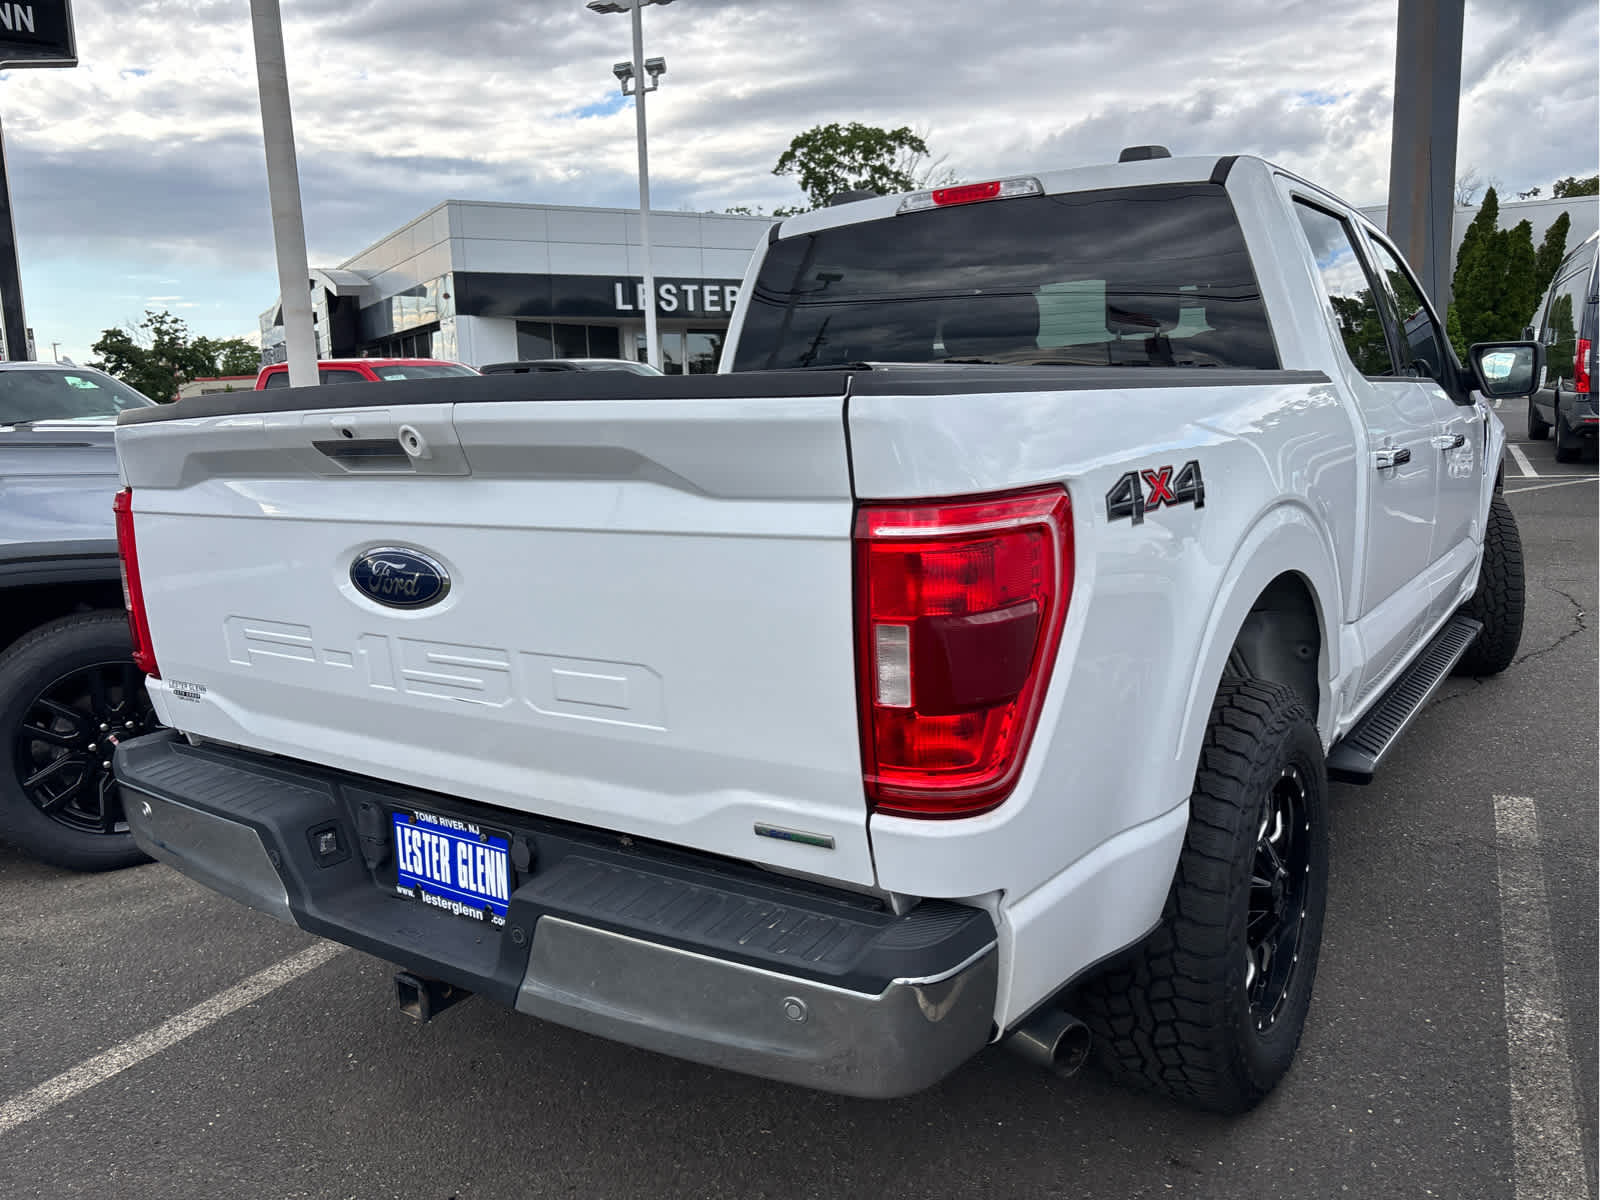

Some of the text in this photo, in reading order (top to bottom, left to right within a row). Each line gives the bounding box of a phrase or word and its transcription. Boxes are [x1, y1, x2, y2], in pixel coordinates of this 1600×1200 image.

[368, 560, 420, 597] Ford
[224, 614, 668, 732] F-150
[414, 811, 480, 835] TOMS RIVER, NJ
[396, 825, 509, 901] LESTER GLENN
[396, 885, 506, 926] www. lesterglenn .co
